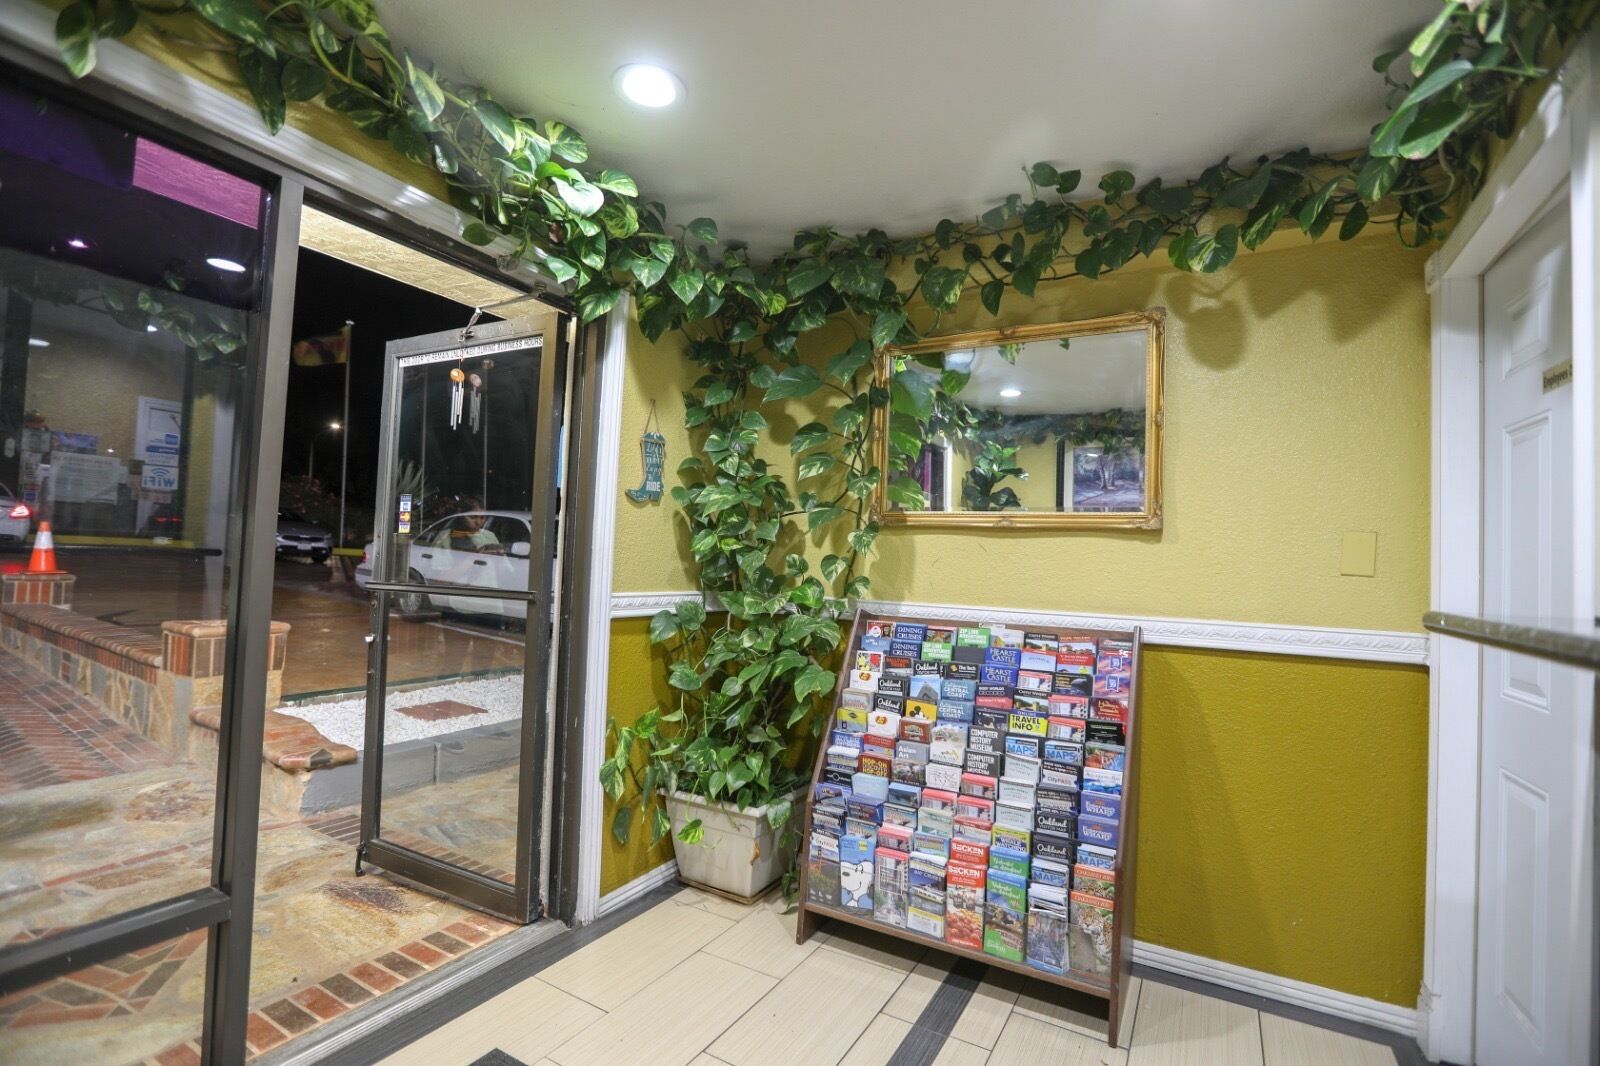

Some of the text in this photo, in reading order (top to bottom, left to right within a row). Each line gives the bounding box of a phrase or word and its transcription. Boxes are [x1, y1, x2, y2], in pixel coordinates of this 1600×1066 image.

[432, 350, 449, 361] REMAIN
[477, 344, 496, 356] DURING
[497, 340, 523, 352] BUSINESS
[523, 336, 543, 348] HOURS
[646, 480, 661, 491] RIDE
[897, 626, 923, 635] DINING
[897, 632, 922, 641] CRUISES
[892, 643, 918, 651] DINING
[892, 650, 918, 658] CRUISES
[990, 648, 1016, 657] HEARST
[991, 655, 1016, 663] CASTLE
[915, 662, 938, 671] Oakland
[985, 666, 1013, 676] HEARST
[986, 674, 1011, 682] CASTLE
[879, 680, 901, 688] Oakland
[944, 686, 969, 695] CENTRAL
[946, 691, 966, 699] COAST
[877, 698, 901, 710] Oakland
[939, 706, 965, 715] CENTRAL
[1012, 713, 1041, 725] TRAVEL
[1012, 723, 1033, 731] INFO
[970, 728, 999, 739] COMPUTER
[970, 736, 993, 745] HISTORY
[970, 743, 994, 752] MUSEUM
[1008, 743, 1036, 756] MAPS
[967, 753, 995, 763] COMPUTER
[1046, 750, 1076, 761] MAPS
[863, 757, 888, 768] HOP-ON
[967, 761, 989, 770] HISTORY
[1087, 806, 1114, 817] WHARF
[1038, 816, 1067, 828] Oakland
[1084, 831, 1111, 841] WHARF
[1037, 843, 1067, 855] Oakland
[1080, 855, 1112, 870] MAPS
[1032, 871, 1066, 884] MAPS
